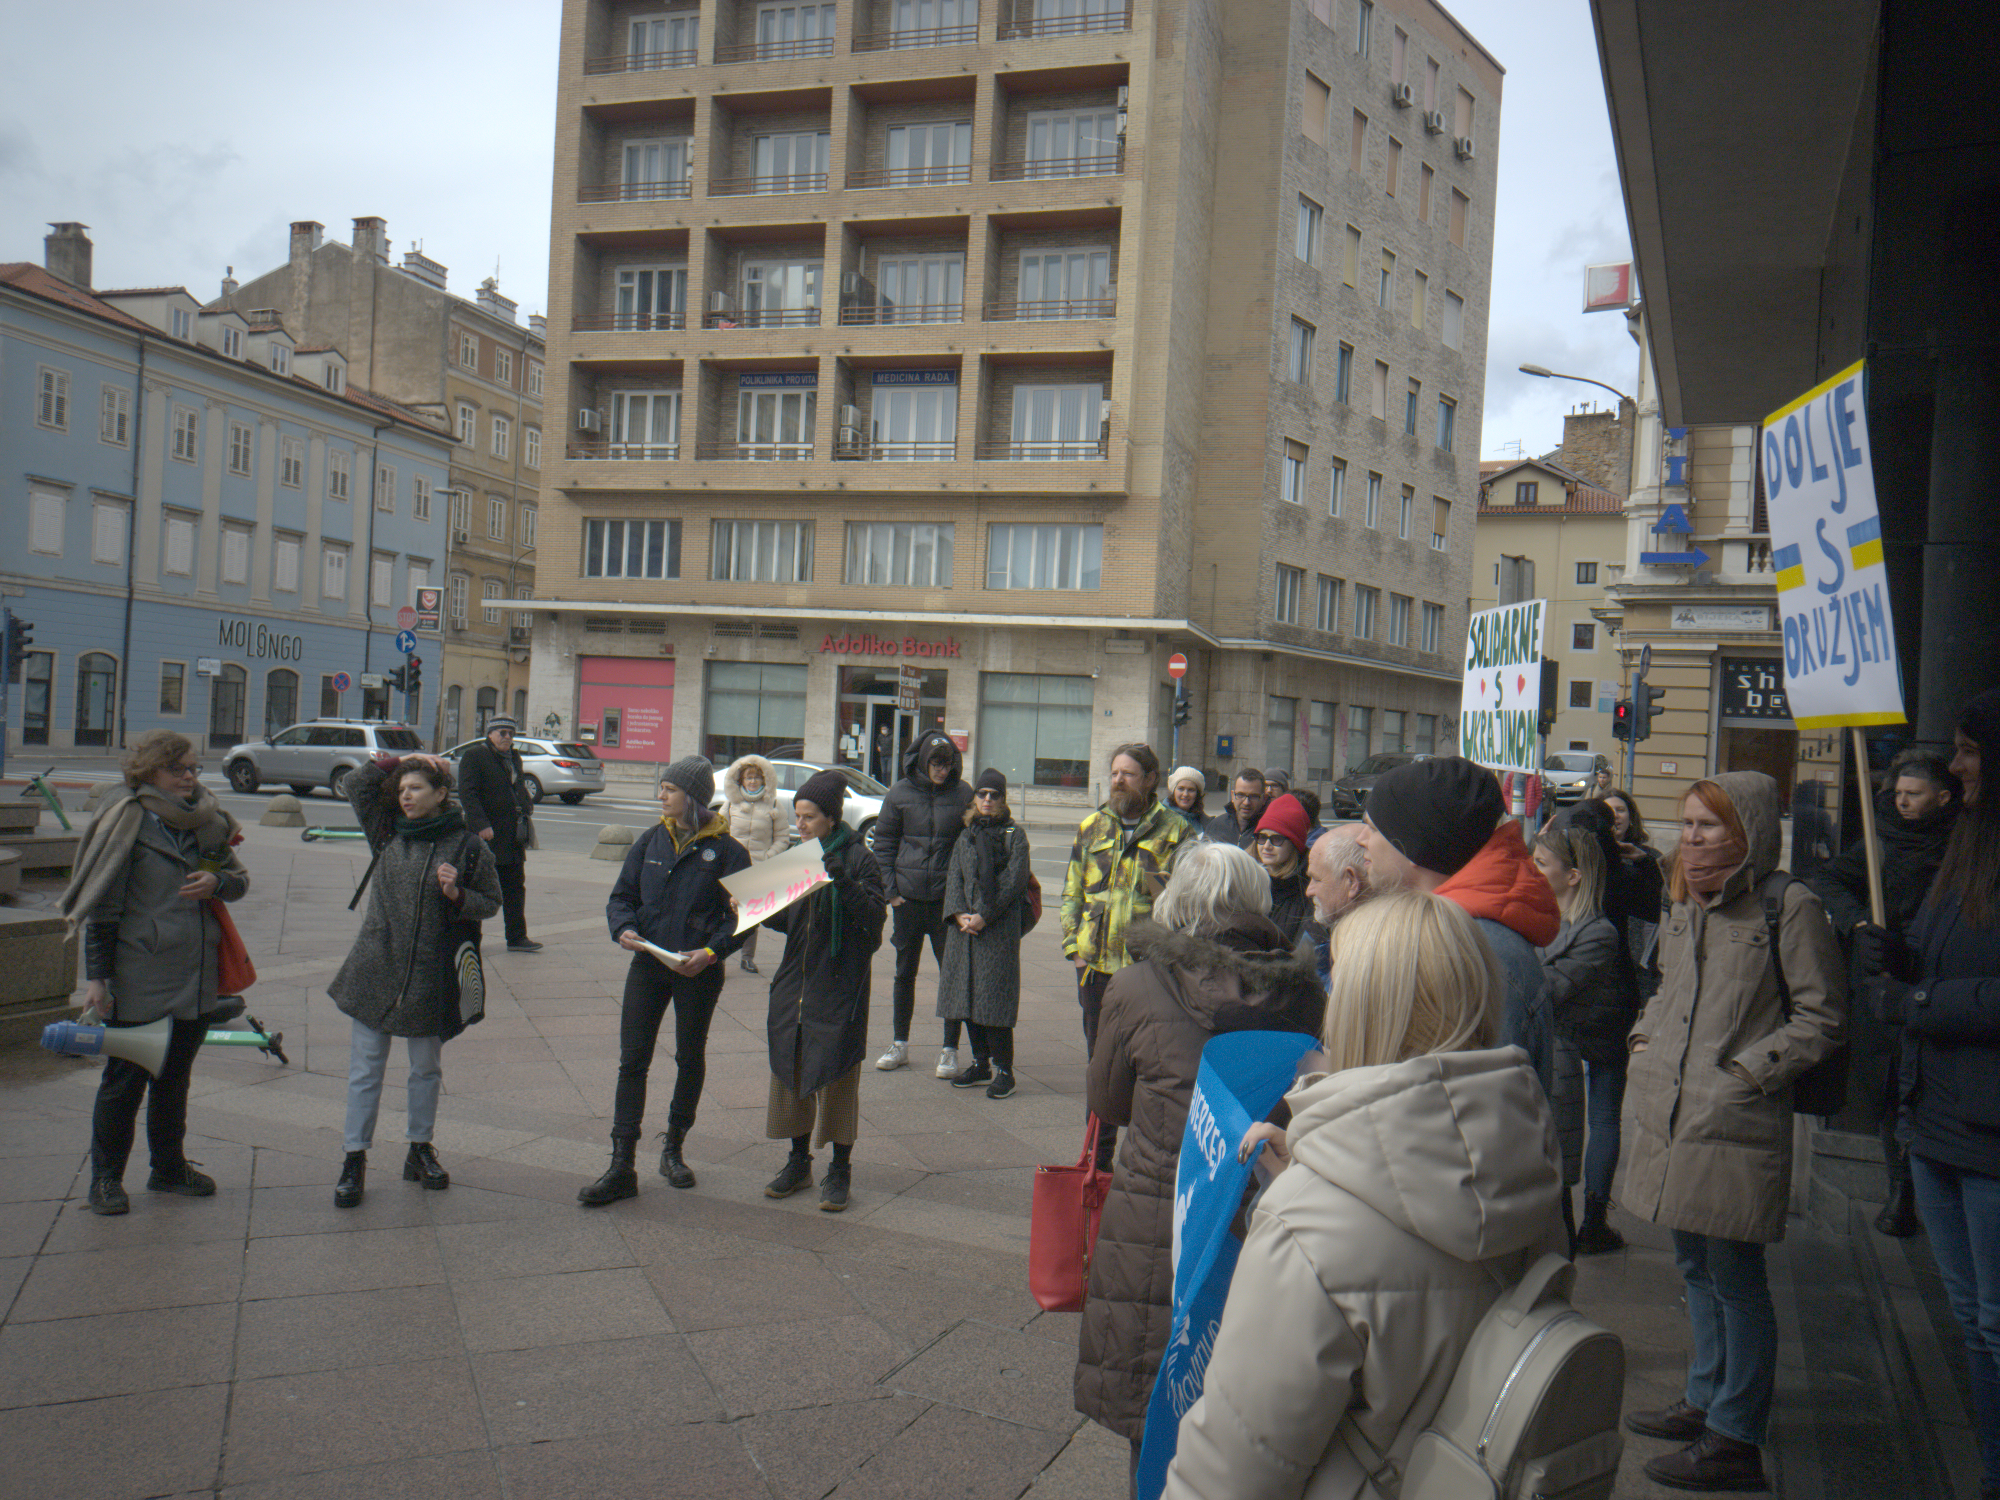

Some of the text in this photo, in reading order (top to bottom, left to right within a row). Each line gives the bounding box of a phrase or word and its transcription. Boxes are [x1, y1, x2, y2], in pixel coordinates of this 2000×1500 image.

[740, 375, 817, 385] POLIKLINIKA PRO VITA
[877, 372, 950, 383] MEDICINA RADA
[1766, 379, 1863, 515] DOLJE
[1816, 518, 1845, 595] S
[398, 612, 417, 623] STOP
[820, 633, 961, 657] Addiko Bank
[1467, 602, 1541, 671] SOLIDARNE
[1784, 583, 1891, 687] ORUŽJEM
[1494, 670, 1503, 709] S
[1462, 709, 1538, 770] UKRAJINOM
[745, 890, 778, 917] za
[212, 1031, 232, 1040] Bolt
